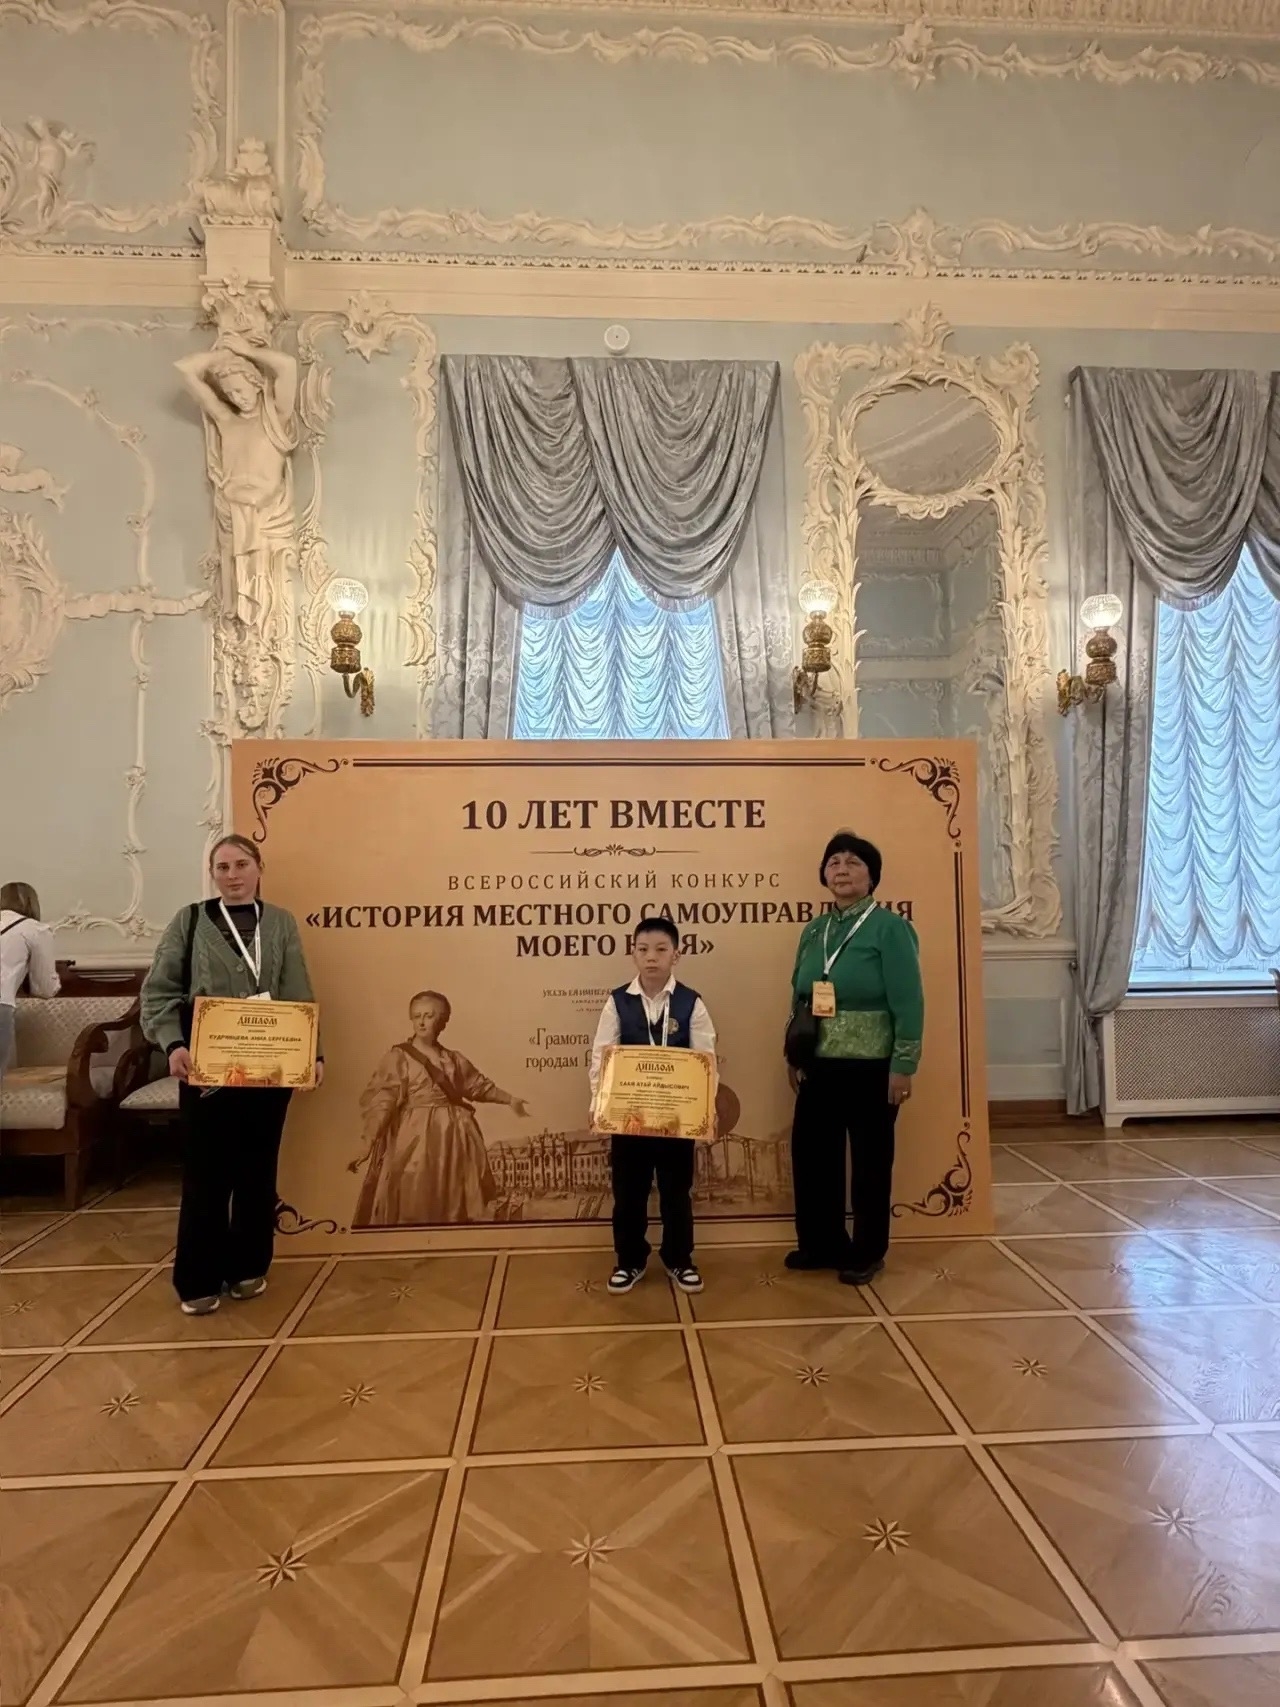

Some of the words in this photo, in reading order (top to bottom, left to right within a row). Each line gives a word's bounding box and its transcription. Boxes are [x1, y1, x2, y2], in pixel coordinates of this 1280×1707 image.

[462, 800, 508, 830] 10
[518, 800, 599, 829] ЛЕТ
[610, 799, 766, 829] ВМЕСТЕ
[448, 870, 658, 891] ВСЕРОССИЙСКИЙ
[671, 873, 781, 888] КОНКУРС
[305, 905, 465, 928] «ИСТОРИЯ
[474, 903, 632, 926] МЕСТНОГО
[516, 934, 616, 957] МОЕГО
[237, 1016, 278, 1026] ДИПЛОМ
[529, 1028, 590, 1050] «Грамота
[526, 1056, 578, 1072] городам
[635, 1063, 675, 1073] ДИПЛОМ
